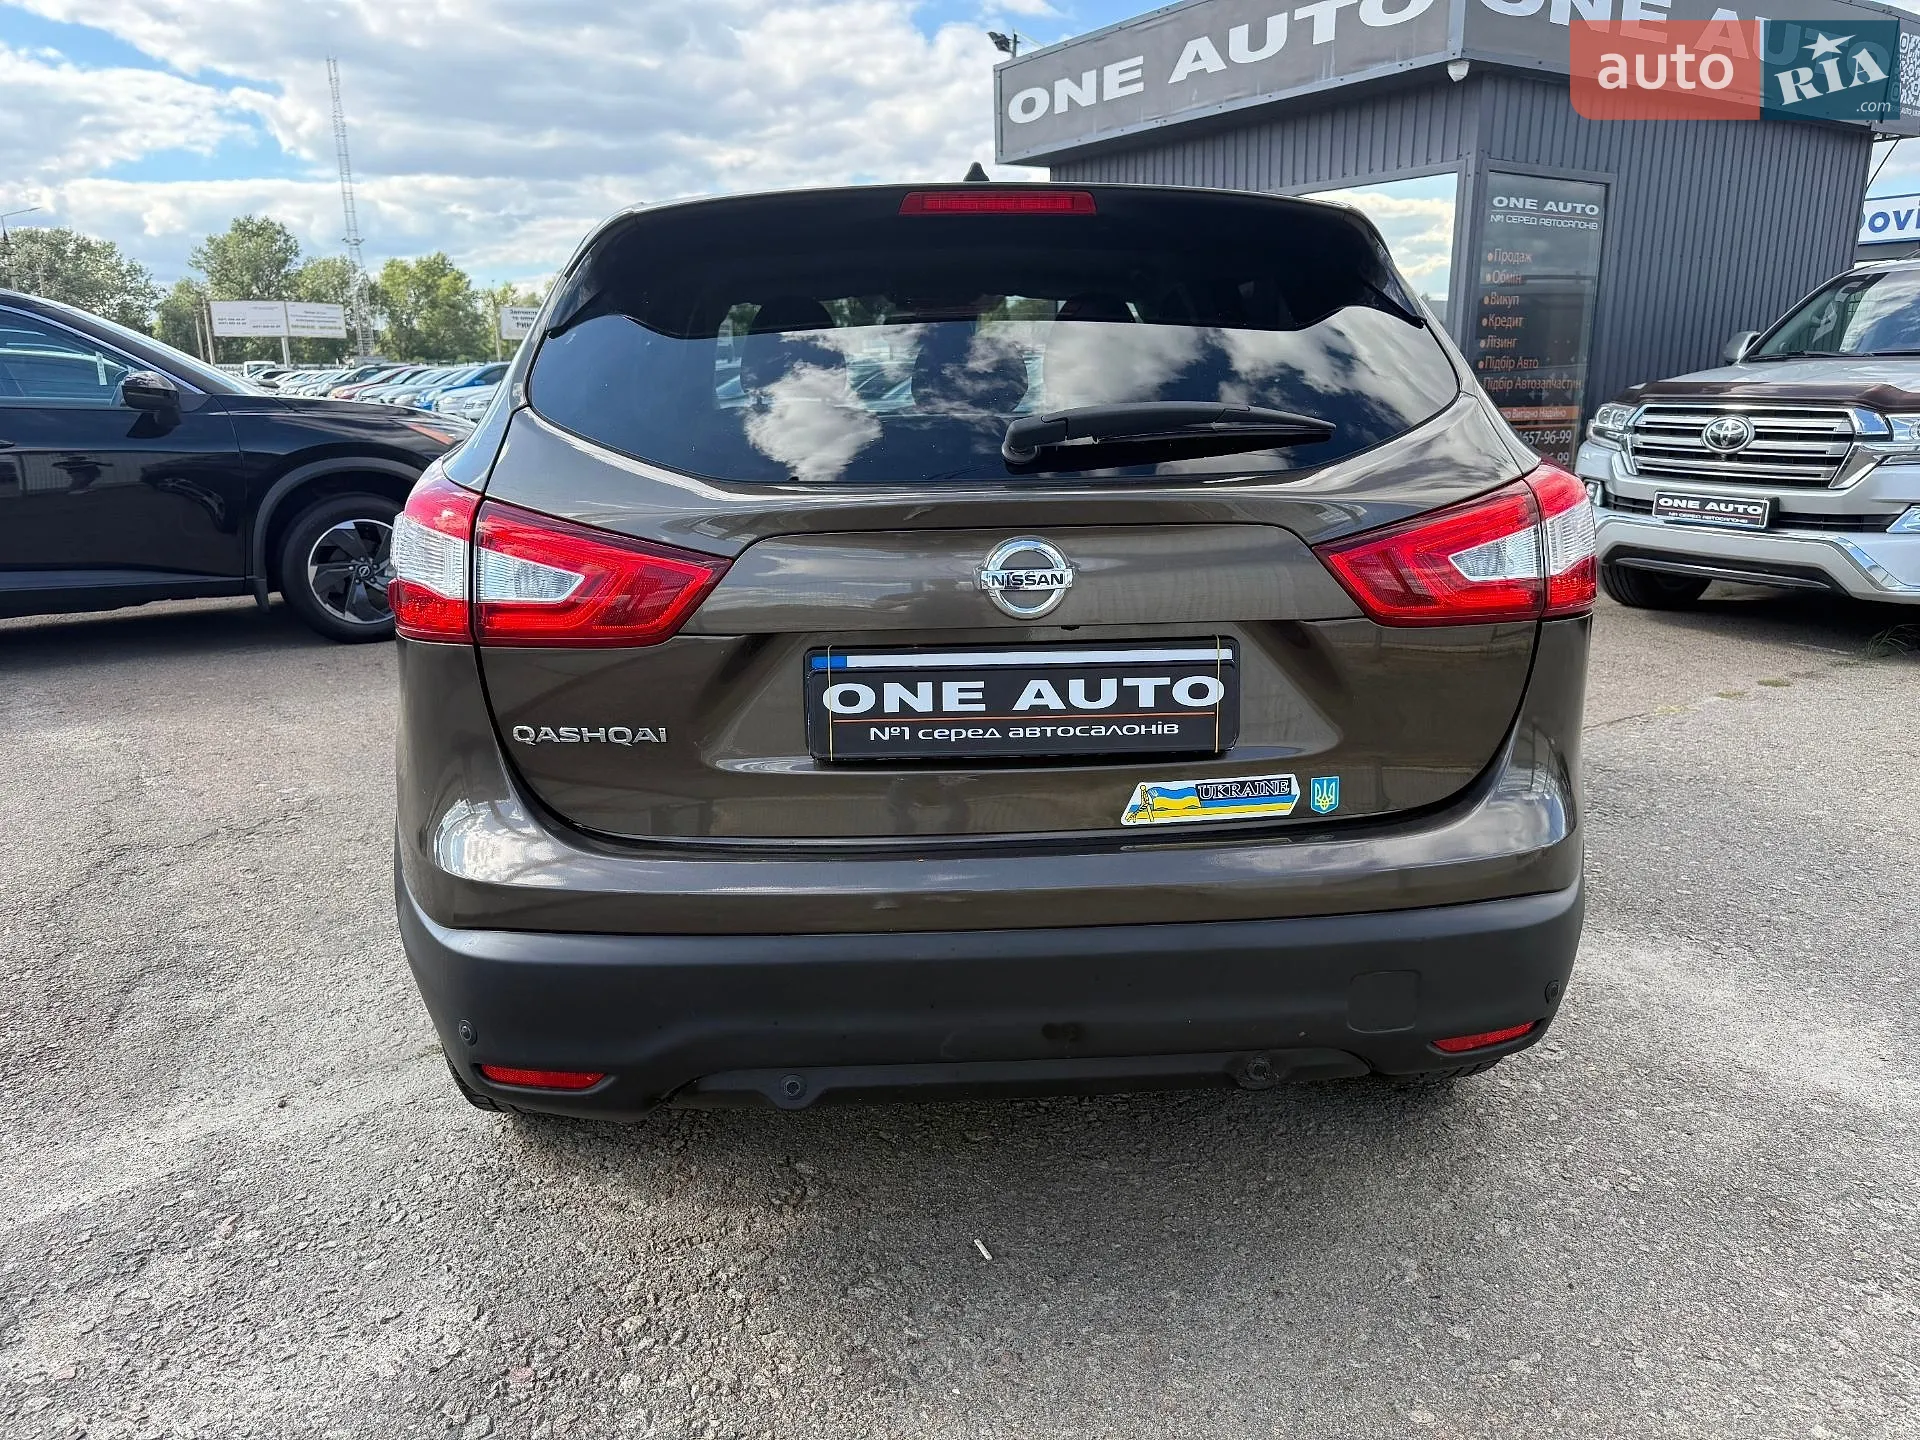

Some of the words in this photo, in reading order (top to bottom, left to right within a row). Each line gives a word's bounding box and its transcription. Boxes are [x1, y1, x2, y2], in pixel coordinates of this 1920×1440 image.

[1008, 55, 1144, 124] ONE
[1492, 196, 1538, 210] ONE
[1543, 200, 1599, 215] AUTO
[1494, 248, 1532, 264] Продаж
[1490, 292, 1519, 308] Викуп
[1488, 314, 1523, 329] Кредит
[1486, 335, 1518, 349] Лізинг
[1485, 355, 1514, 371] Підбір
[1517, 356, 1539, 369] Авто
[1483, 377, 1513, 391] Підбір
[1658, 498, 1700, 509] ONE
[1705, 501, 1762, 514] AUTO
[991, 573, 1064, 586] NISSAN
[822, 681, 986, 714] ONE
[1011, 675, 1225, 711] AUTO
[512, 725, 667, 746] QASHQAI
[870, 726, 910, 741] №1
[1199, 780, 1290, 800] UKRAINE
